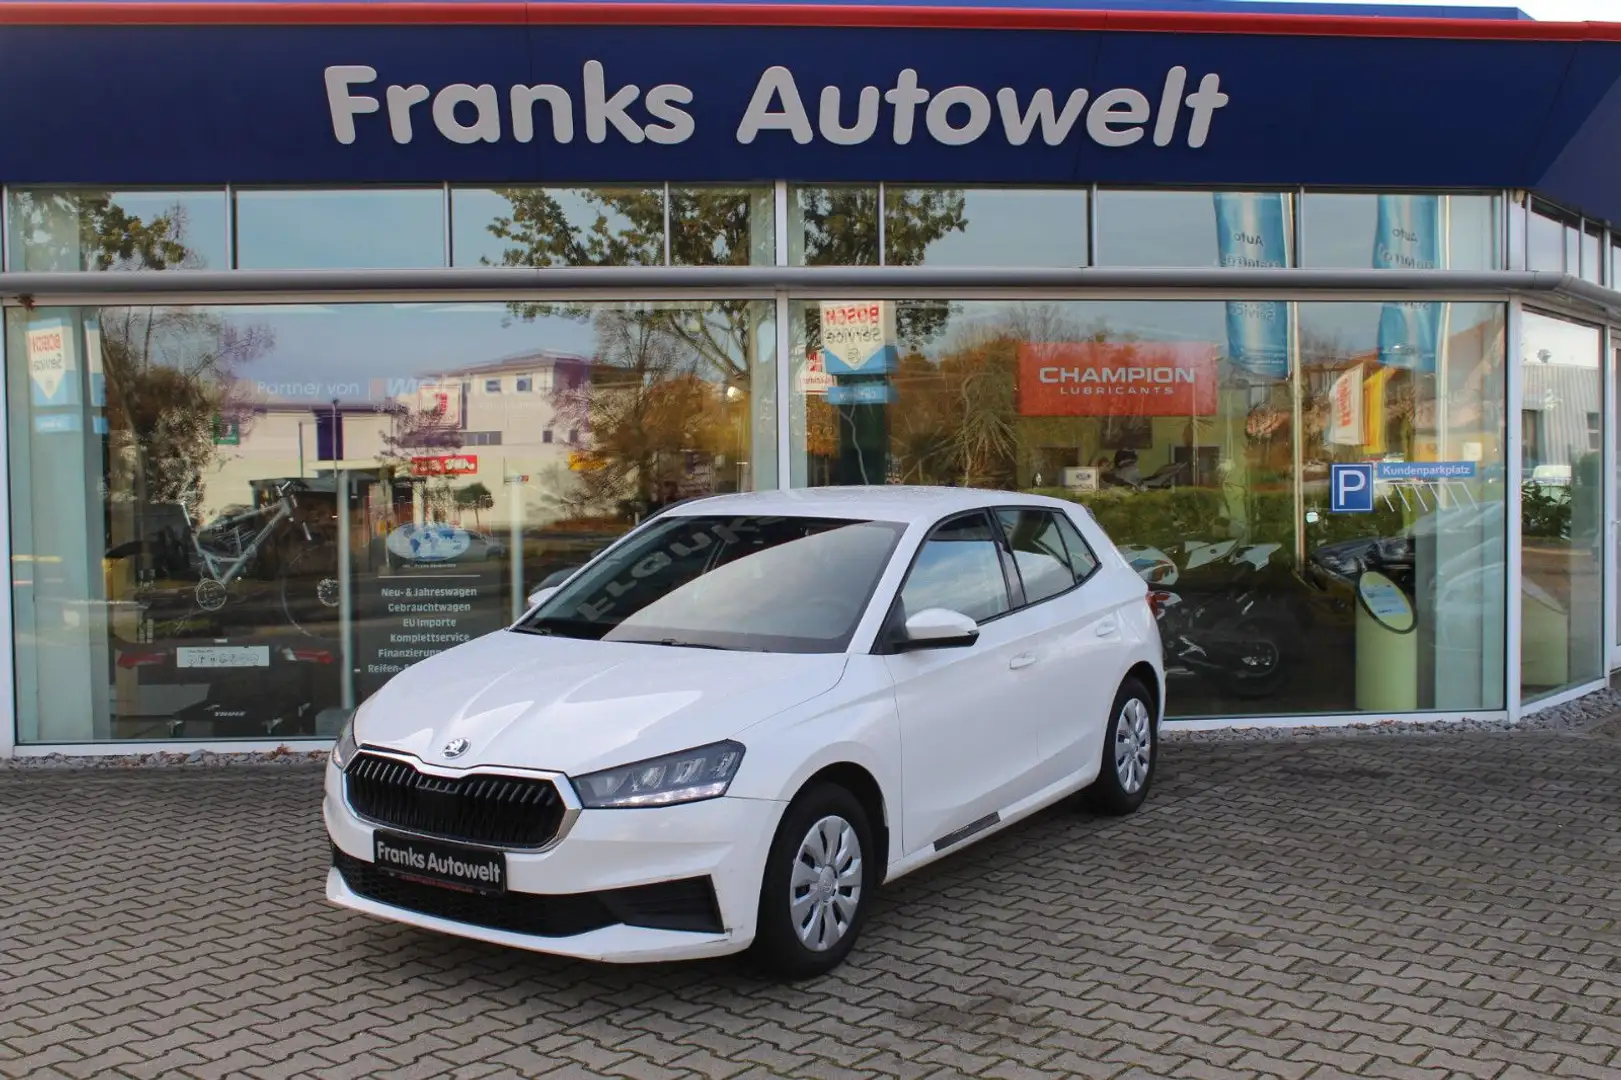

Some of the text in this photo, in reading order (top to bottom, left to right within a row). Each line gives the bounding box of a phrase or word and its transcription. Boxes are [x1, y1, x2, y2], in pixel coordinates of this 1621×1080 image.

[324, 59, 1229, 149] Franks Autowelt
[1039, 367, 1195, 383] CHAMPION
[257, 381, 360, 395] Partner von
[1060, 385, 1174, 395] LUBRICANTS
[1382, 465, 1471, 477] Kundenparkplatz
[1338, 470, 1366, 506] P
[381, 588, 477, 598] Neu- & Jahreswagen
[388, 603, 471, 613] Gebrauchtwagen
[403, 618, 456, 629] EU Importe
[390, 632, 470, 643] Komplettservice
[376, 840, 501, 883] Franks Autowelt
